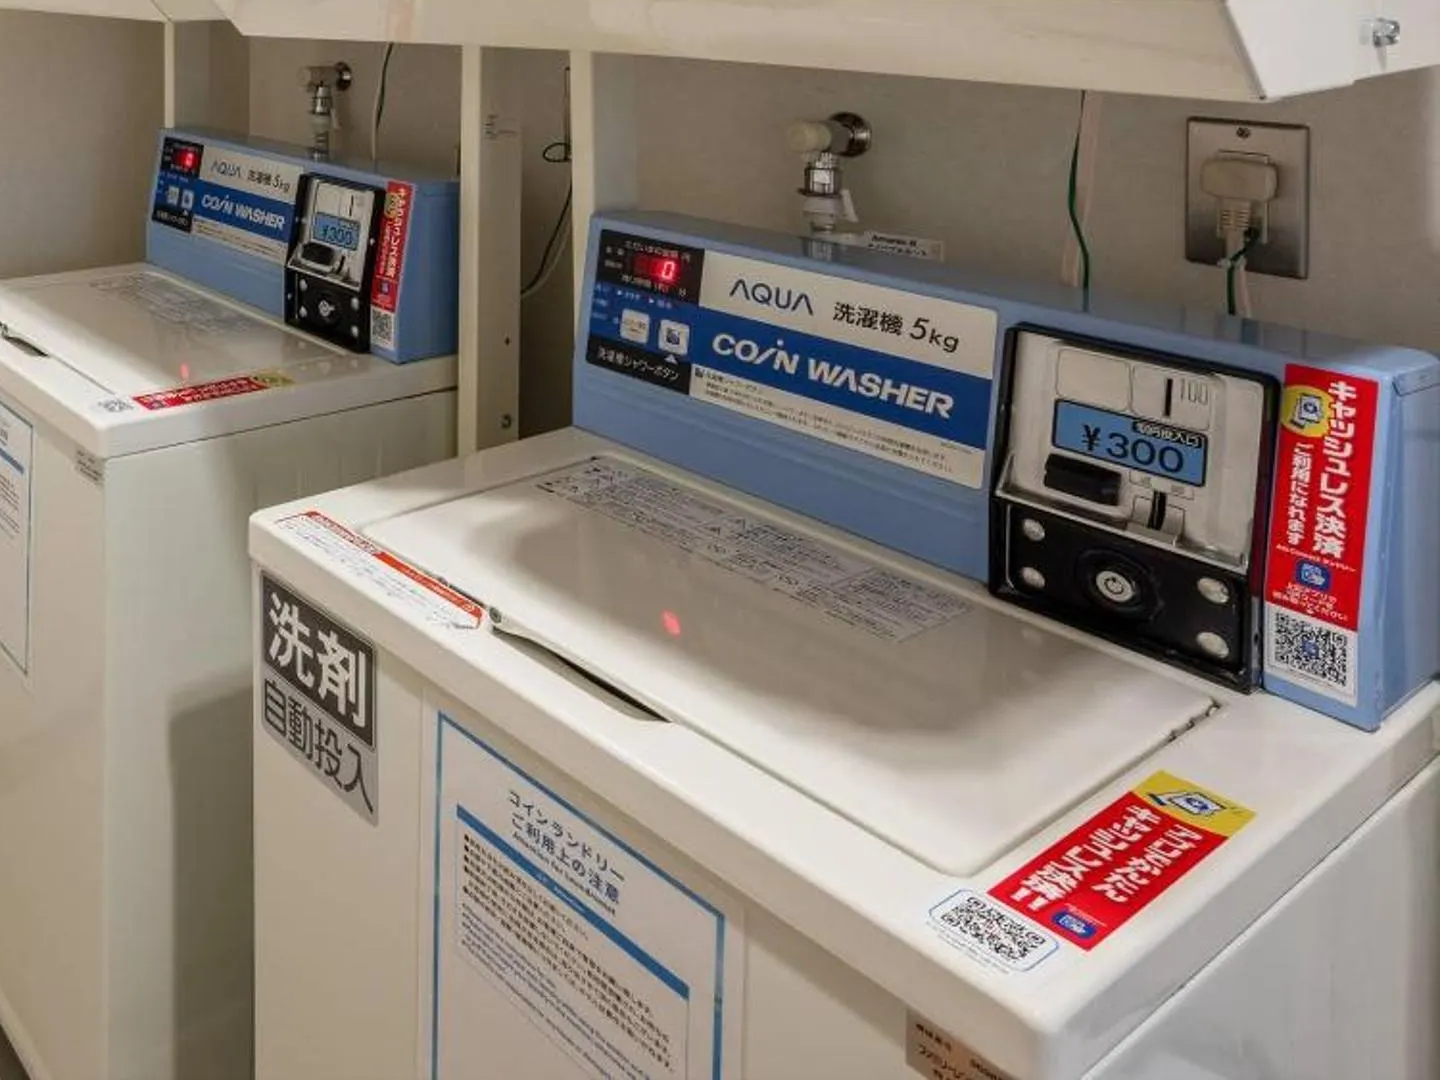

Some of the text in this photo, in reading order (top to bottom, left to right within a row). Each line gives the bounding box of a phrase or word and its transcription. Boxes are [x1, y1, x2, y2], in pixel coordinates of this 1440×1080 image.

[235, 203, 287, 231] WASHER
[660, 260, 676, 281] 0
[730, 279, 814, 316] AQUA
[833, 301, 904, 336] 洗濯機
[712, 333, 955, 420] COIN WASHER
[1287, 442, 1315, 546] ご利用になれます
[1313, 381, 1358, 559] キャッシュレス決済
[268, 591, 366, 729] 洗剤
[264, 678, 374, 815] 自動投入
[509, 789, 625, 882] コインランドリー
[511, 811, 620, 906] ご利用上の注意
